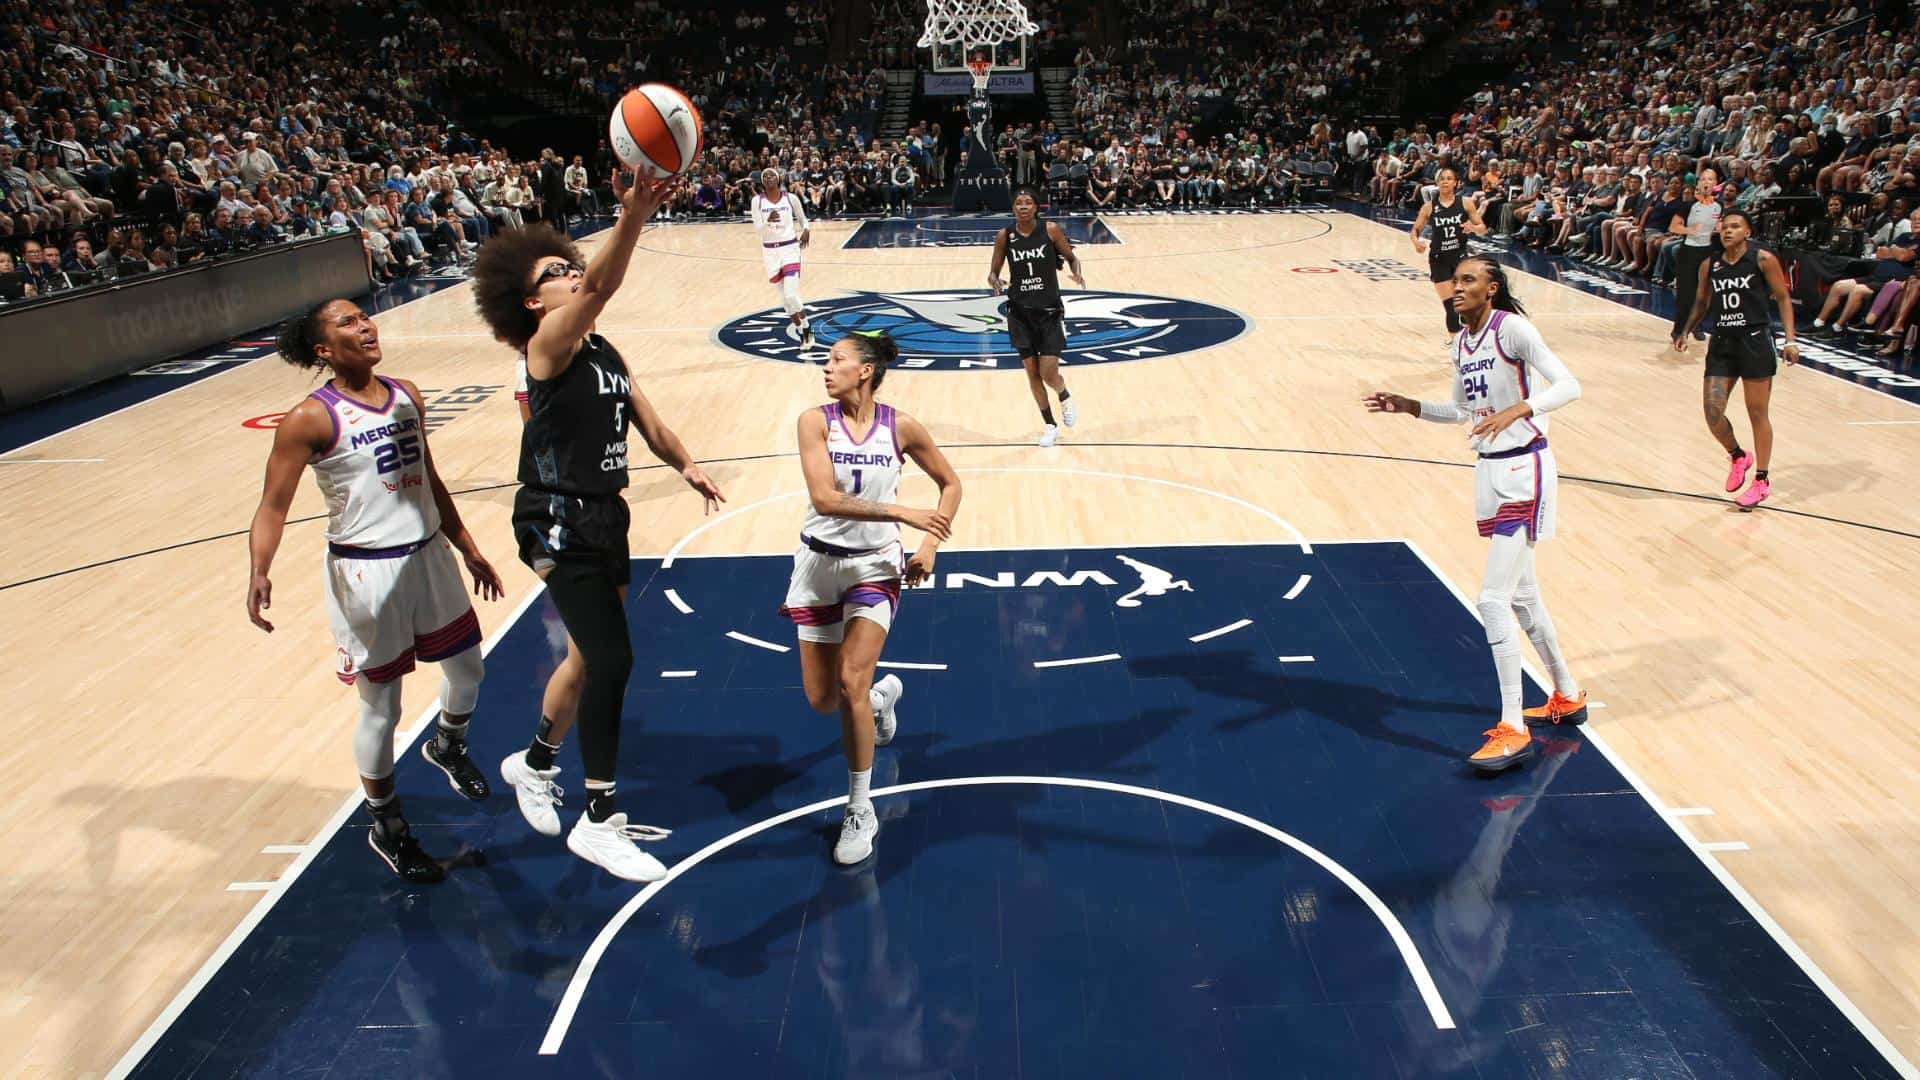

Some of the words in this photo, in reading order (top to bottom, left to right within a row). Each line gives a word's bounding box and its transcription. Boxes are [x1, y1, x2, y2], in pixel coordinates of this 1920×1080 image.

[1434, 213, 1463, 227] LYNX
[1444, 226, 1456, 238] 12
[1010, 244, 1047, 262] LYNX
[1026, 262, 1033, 276] 1
[1020, 284, 1044, 292] CLINIC
[1021, 277, 1042, 285] MAYO
[1711, 273, 1755, 293] LYNX
[1722, 293, 1741, 310] 10
[1720, 312, 1745, 321] MAYO
[1460, 357, 1496, 376] ERCURY
[589, 361, 632, 395] LYN
[1463, 374, 1489, 401] 24
[614, 402, 625, 432] 5
[373, 435, 422, 475] 25
[851, 469, 863, 494] 1
